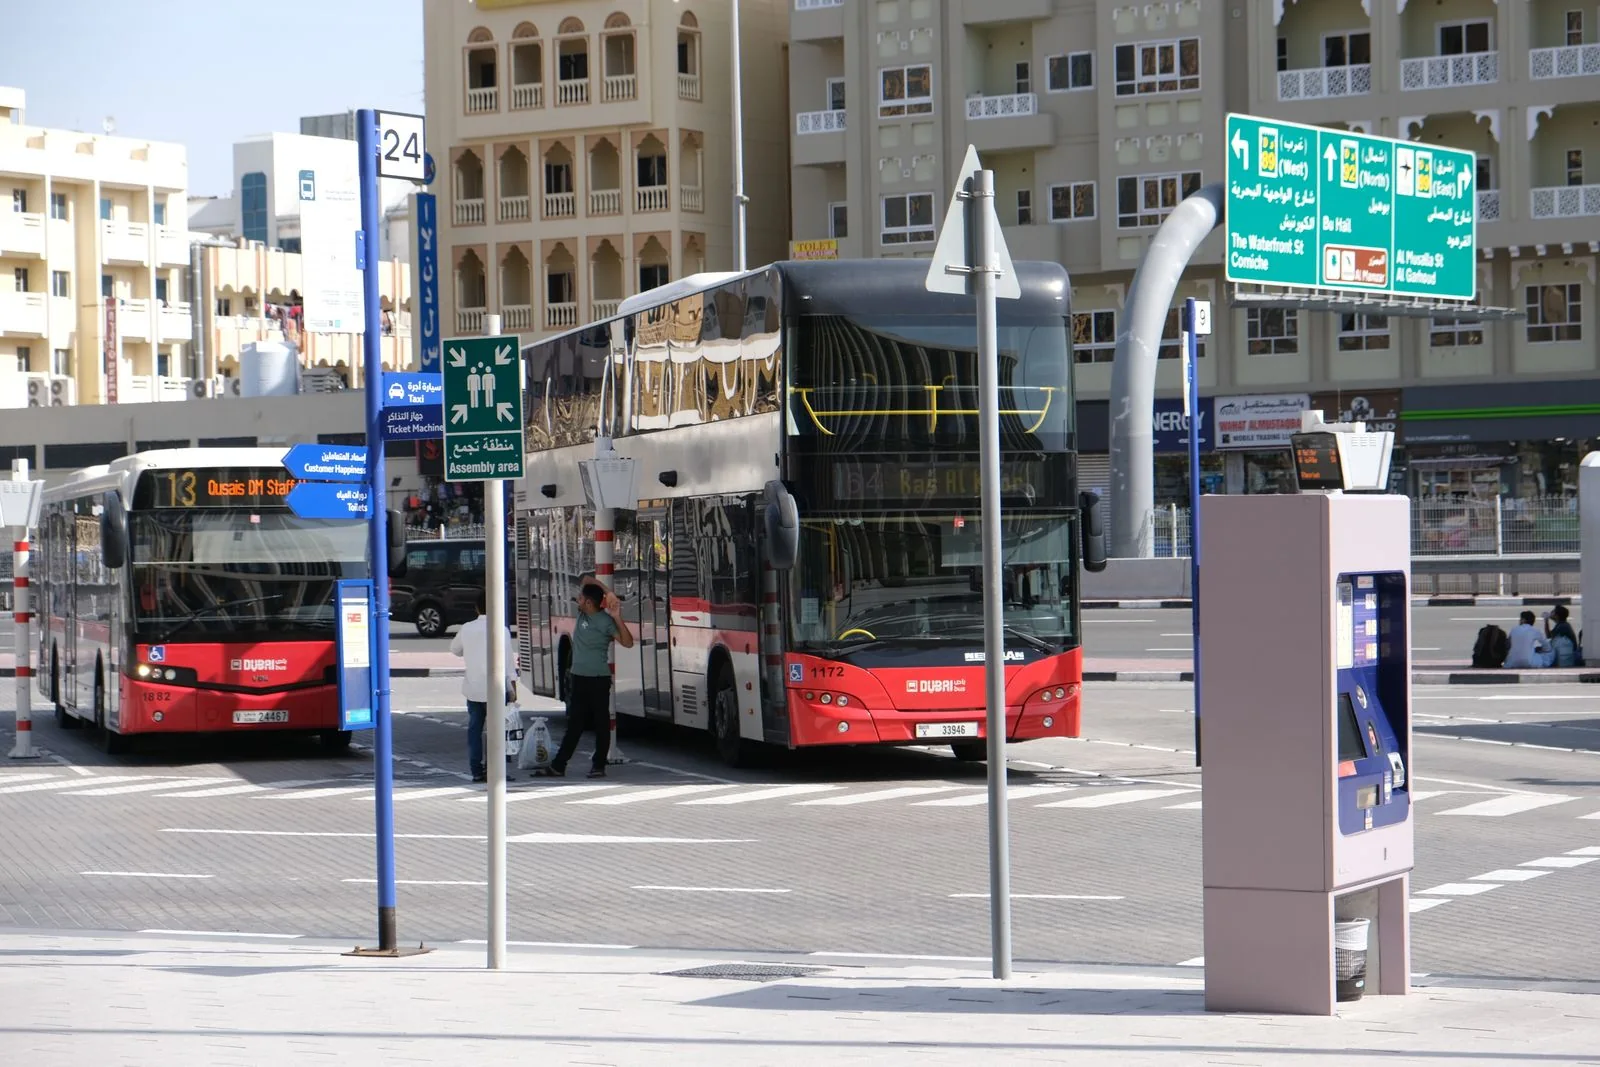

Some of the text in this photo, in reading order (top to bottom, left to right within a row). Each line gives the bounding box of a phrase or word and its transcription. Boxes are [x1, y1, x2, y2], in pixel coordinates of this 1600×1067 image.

[383, 128, 421, 164] 24
[1261, 151, 1276, 171] 89
[1279, 158, 1309, 181] (West)
[1343, 163, 1357, 183] 92
[1359, 169, 1390, 192] (North)
[1231, 180, 1316, 208] شارع الواجهة البحرية
[1432, 180, 1457, 201] (East)
[1278, 213, 1316, 233] الكورنيش
[1453, 210, 1473, 227] شارع
[1230, 231, 1305, 256] The Waterfront St
[1230, 252, 1270, 273] Corniche
[1396, 249, 1405, 265] Al
[1434, 253, 1444, 269] St
[1396, 266, 1405, 283] Al
[1199, 308, 1206, 326] 9
[407, 380, 442, 393] سيارة أجرة
[407, 394, 425, 404] Taxi
[387, 412, 424, 423] جهاز التذاكر
[387, 423, 444, 434] Ticket Machine
[453, 440, 480, 459] تجمع
[482, 437, 514, 452] منطقة
[304, 462, 367, 476] Customer Happiness
[449, 461, 519, 475] Assembly area
[167, 471, 197, 507] 13
[207, 479, 245, 496] Qusais
[247, 479, 263, 495] DM
[346, 502, 368, 512] Toilets
[964, 651, 1024, 662] NEAN
[243, 659, 275, 672] DUBAI
[810, 666, 845, 679] 1172
[920, 680, 954, 694] DUBAI
[143, 691, 171, 701] 1882
[258, 711, 287, 722] 24467
[942, 725, 966, 735] 33946
